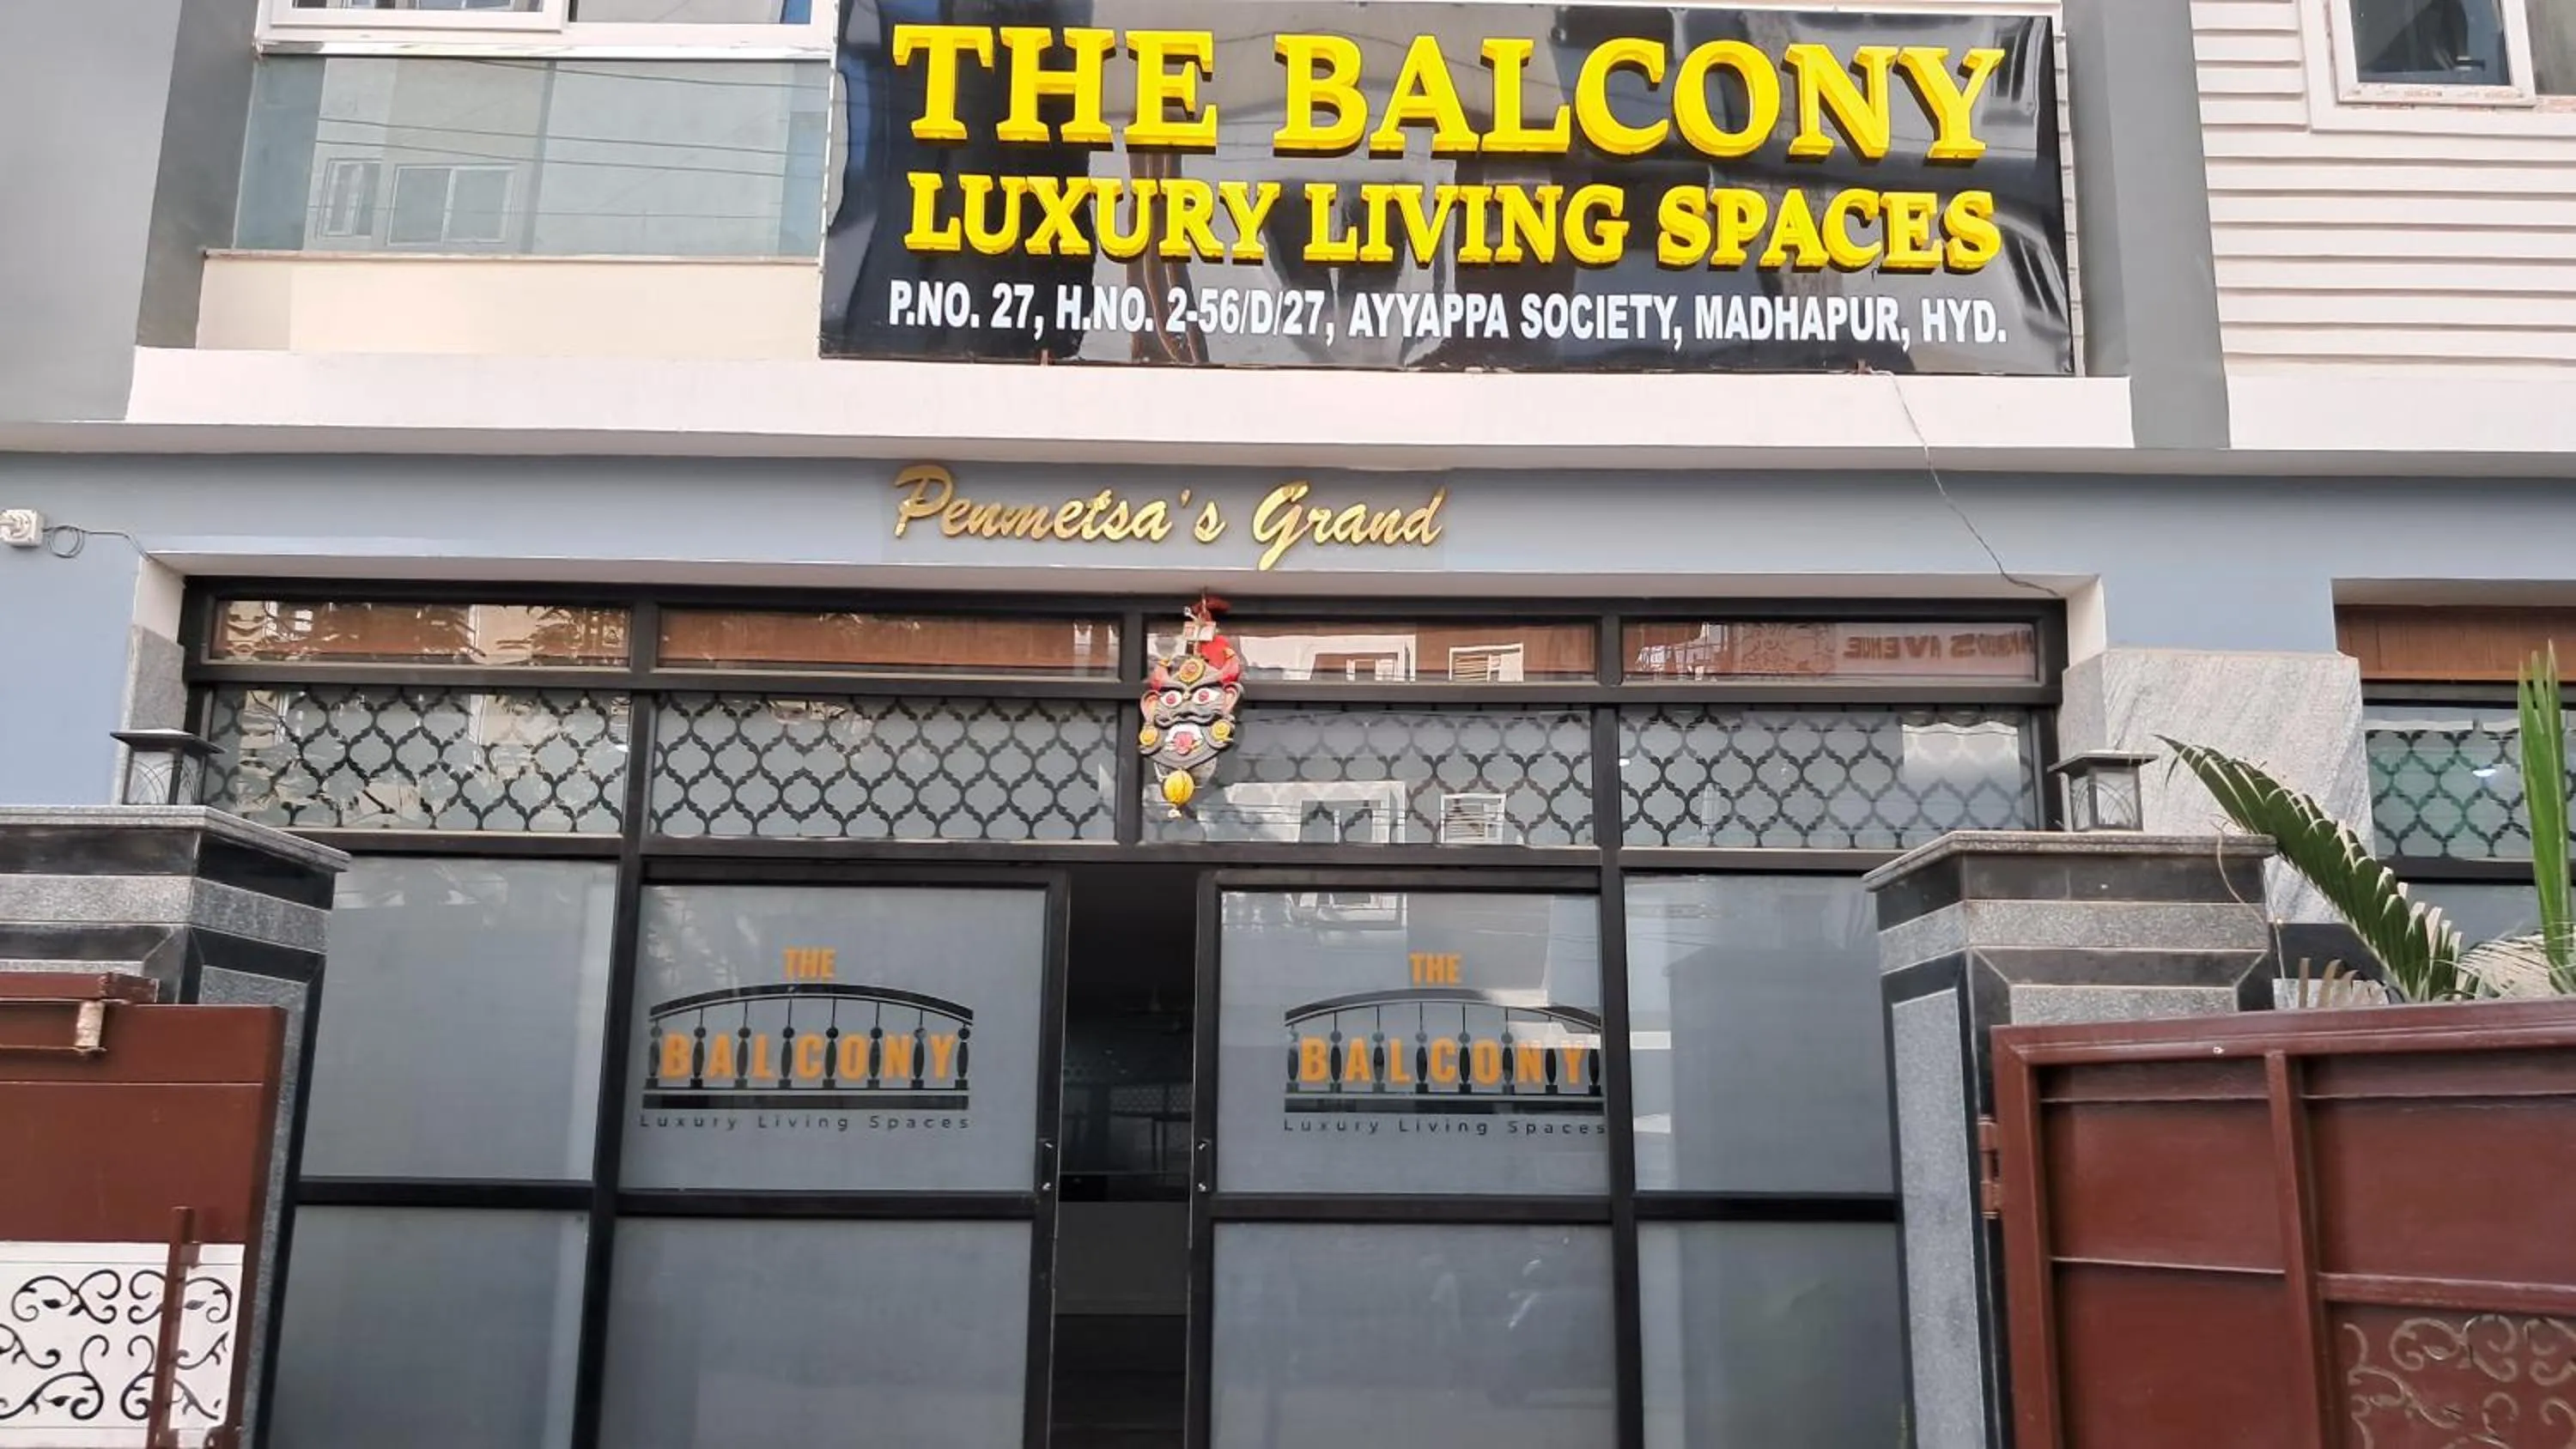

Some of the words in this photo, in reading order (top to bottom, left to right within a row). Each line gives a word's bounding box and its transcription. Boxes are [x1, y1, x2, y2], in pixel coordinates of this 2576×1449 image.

[893, 25, 1218, 154] THE
[1274, 33, 2004, 160] BALCONY
[905, 173, 1279, 263] LUXURY
[1303, 183, 1630, 268] LIVING
[1657, 185, 2002, 271] SPACES
[889, 280, 981, 326] P.NO.
[992, 284, 1045, 342] 27,
[1056, 287, 1154, 333] H.NO.
[1165, 288, 1336, 345] 2-56/D/27,
[1349, 294, 1509, 339] AYYAPPA
[1520, 294, 1681, 350] SOCIETY,
[1695, 295, 1910, 352] MADHAPUR,
[1922, 299, 2007, 343] HYD.
[894, 464, 1224, 542] Penmetsa's
[1253, 481, 1447, 570] Grand
[783, 948, 836, 980] THE
[1410, 953, 1461, 985] THE
[660, 1033, 956, 1079] BALCONY
[1301, 1037, 1588, 1085] BALCONY
[640, 1116, 736, 1131] Luxury
[757, 1116, 848, 1131] Living
[869, 1116, 969, 1131] Spaces
[1284, 1119, 1379, 1134] Luxury
[1399, 1119, 1488, 1136] Living
[1508, 1120, 1606, 1135] Spaces
